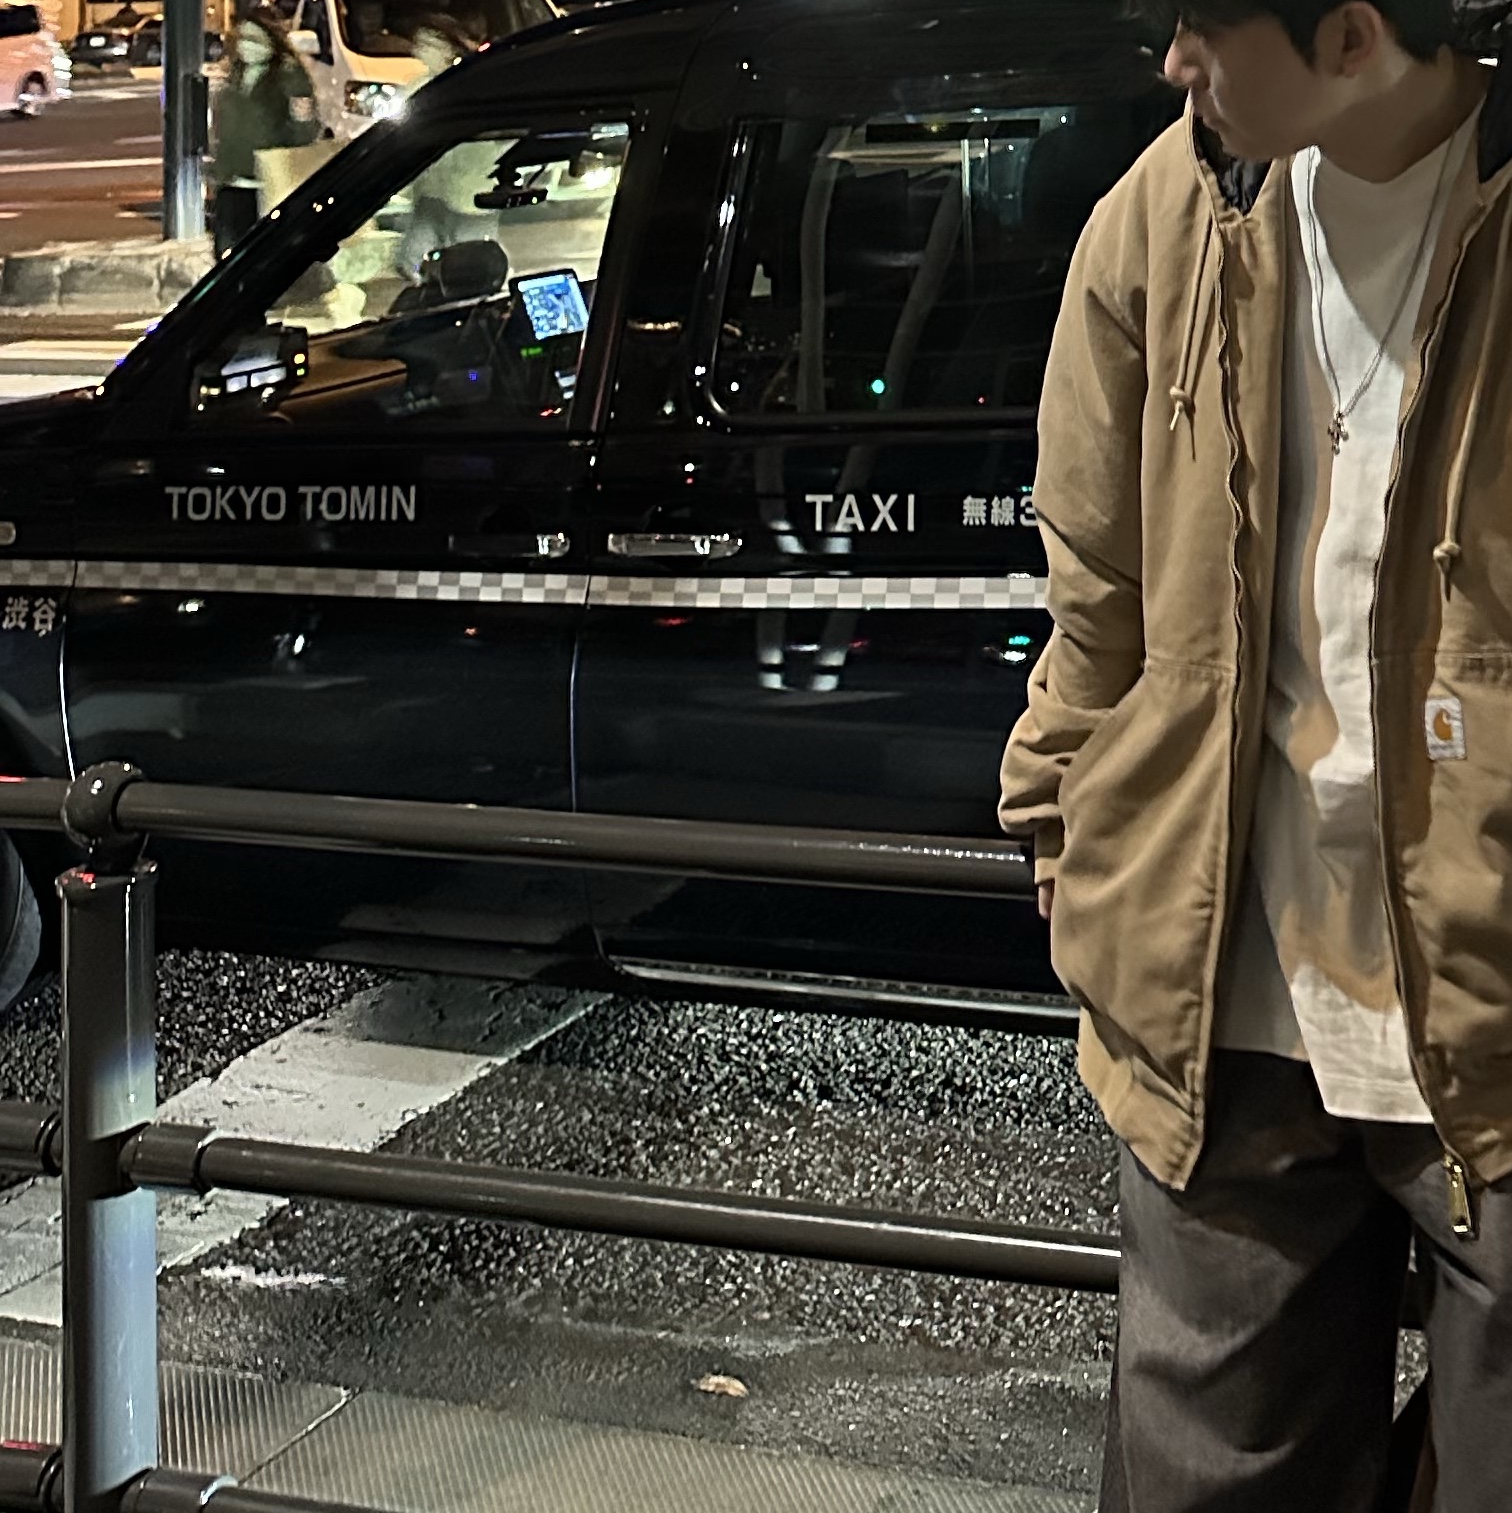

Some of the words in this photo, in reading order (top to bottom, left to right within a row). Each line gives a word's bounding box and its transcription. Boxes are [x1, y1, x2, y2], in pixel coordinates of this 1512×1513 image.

[165, 485, 287, 521] TOKYO
[298, 485, 416, 521] TOMIN
[805, 493, 915, 532] TAXI
[2, 596, 57, 637] 渋谷
